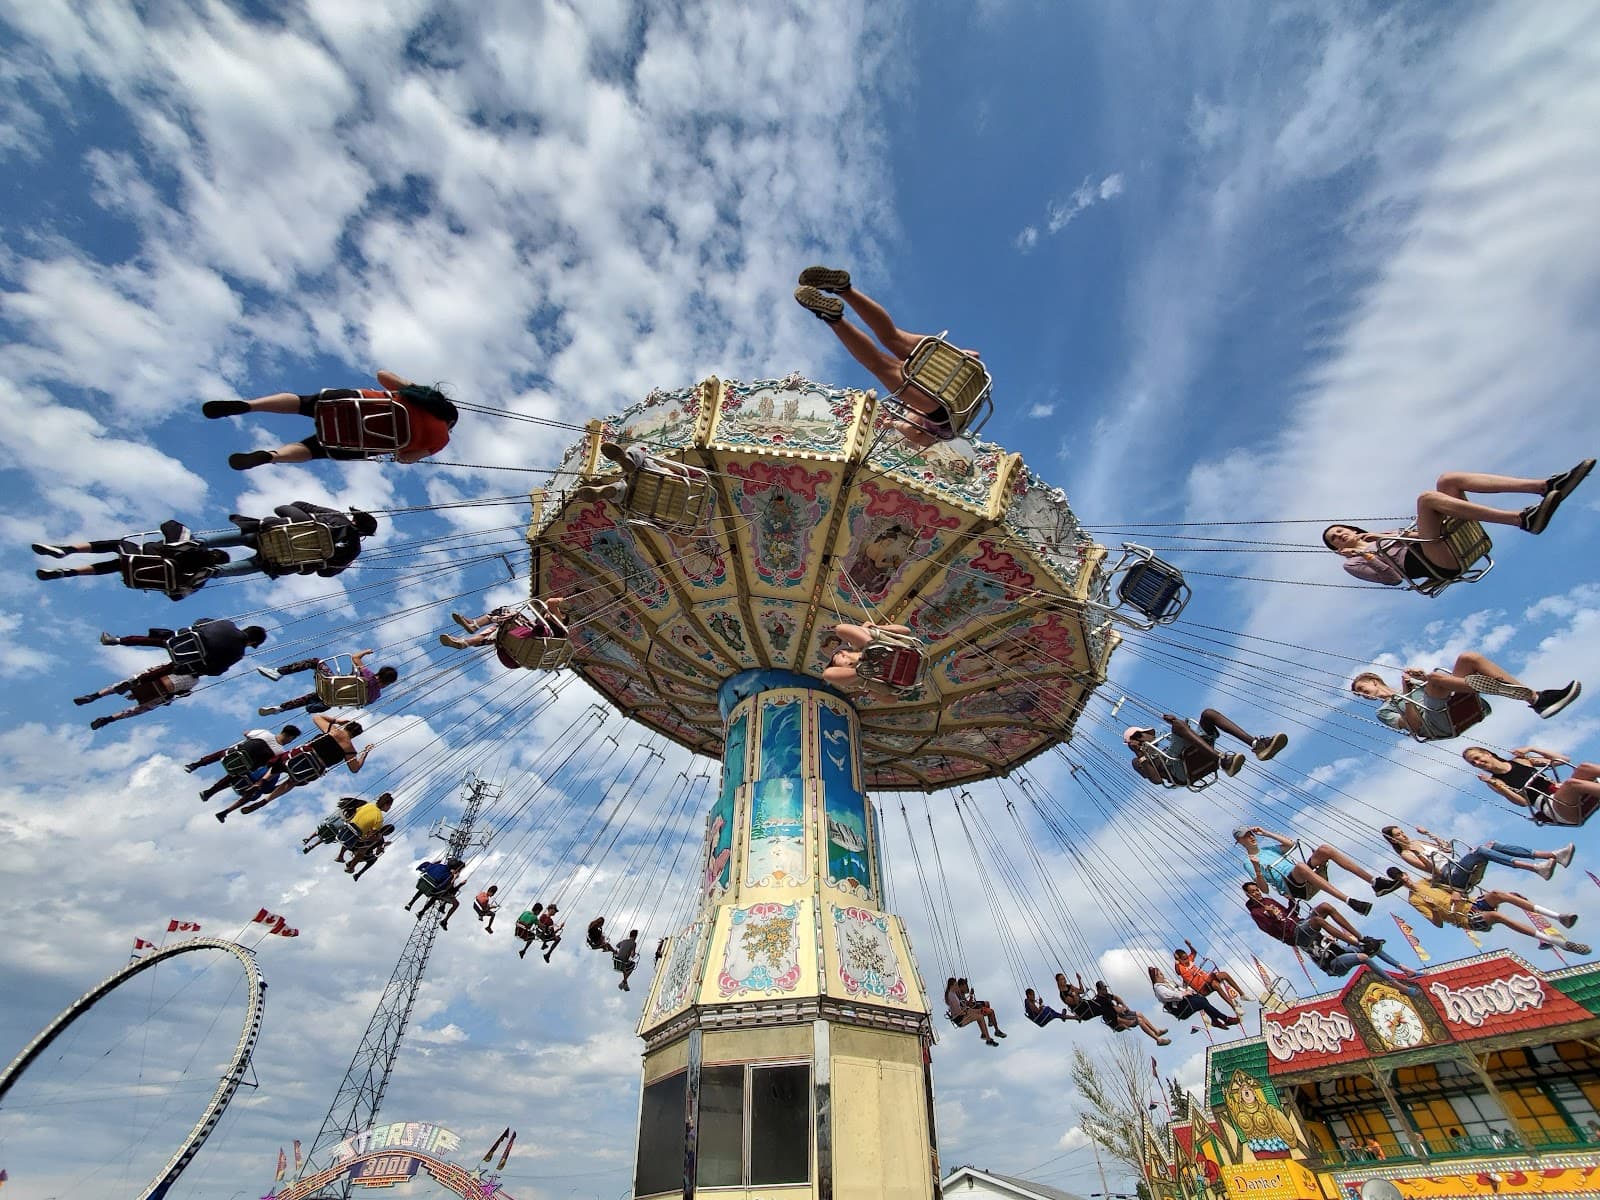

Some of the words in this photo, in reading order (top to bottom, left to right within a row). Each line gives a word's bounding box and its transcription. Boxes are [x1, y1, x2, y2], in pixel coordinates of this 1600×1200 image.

[331, 1121, 462, 1163] STARSHIP
[362, 1156, 411, 1177] 3000
[1233, 1174, 1284, 1192] Danke!
